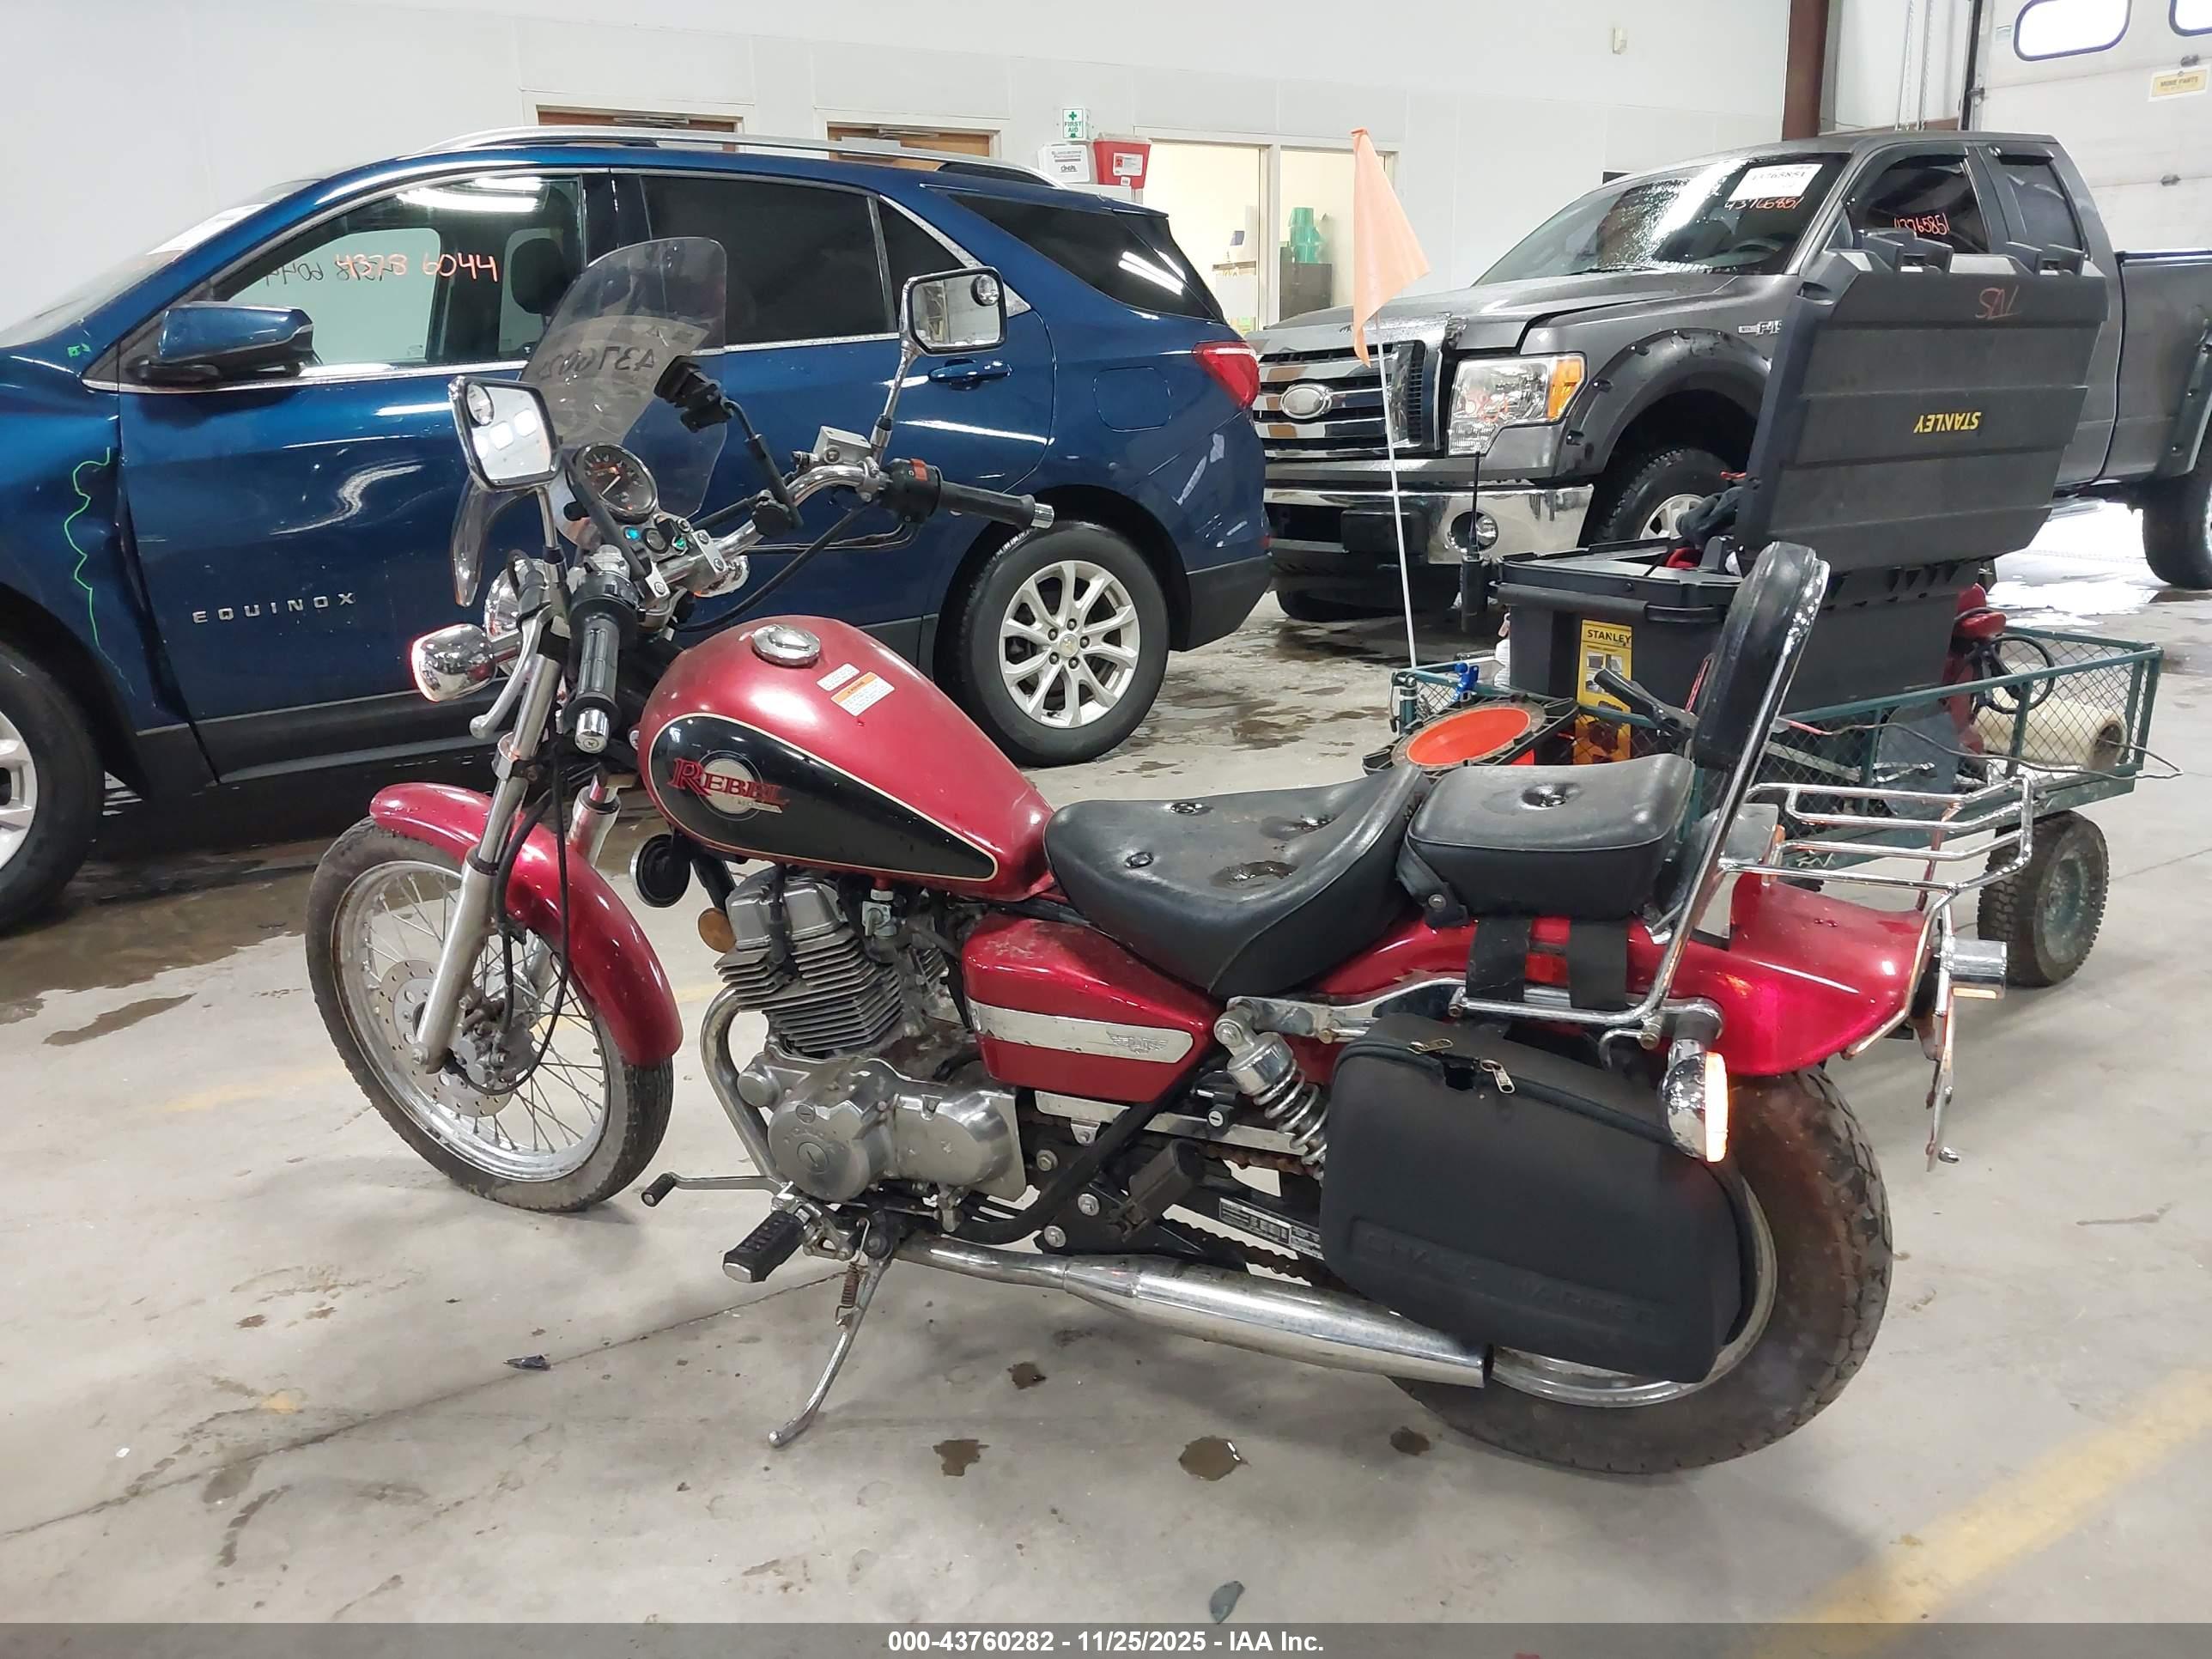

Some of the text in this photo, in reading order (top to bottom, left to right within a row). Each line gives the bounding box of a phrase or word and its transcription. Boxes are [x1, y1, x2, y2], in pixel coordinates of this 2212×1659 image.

[422, 252, 498, 282] 6044
[1913, 411, 1982, 434] STANLEY
[191, 592, 356, 623] EQUINOX
[1587, 629, 1632, 645] STANLEY
[667, 757, 790, 805] REBEL
